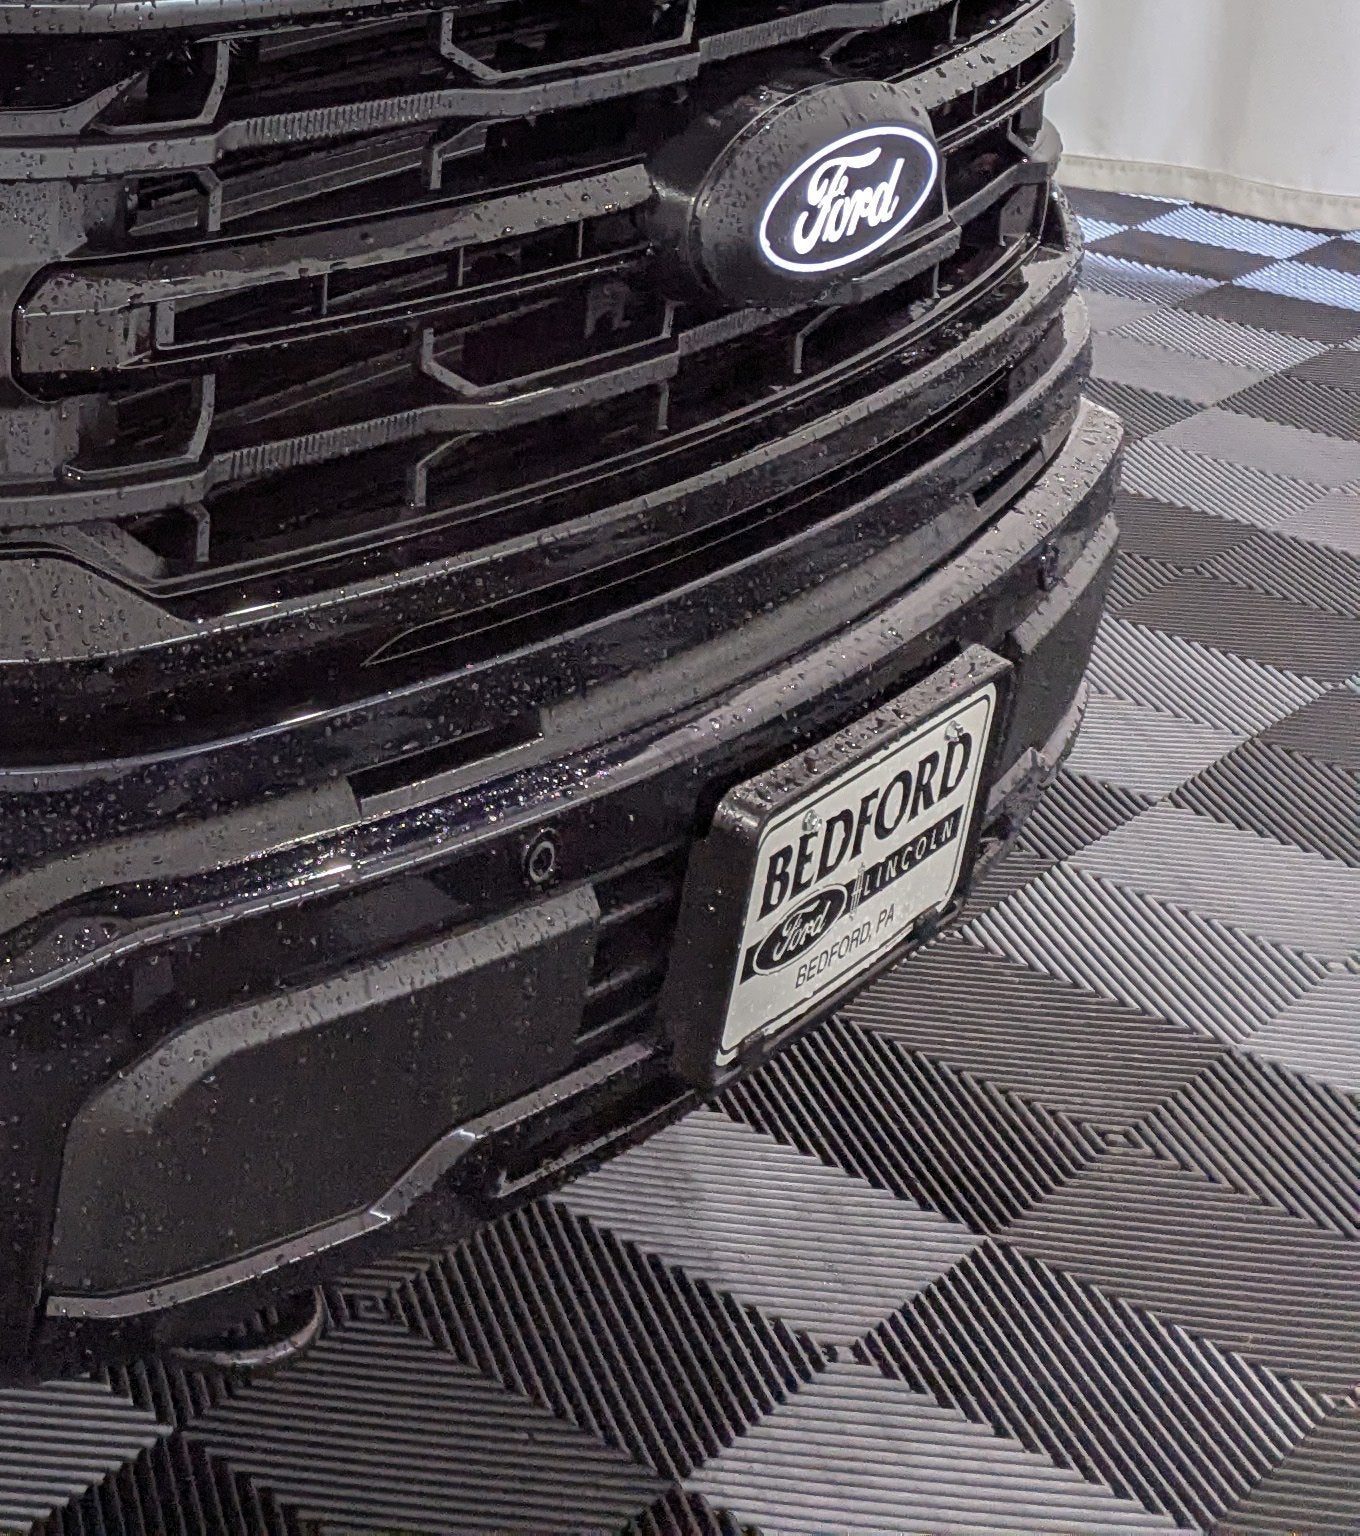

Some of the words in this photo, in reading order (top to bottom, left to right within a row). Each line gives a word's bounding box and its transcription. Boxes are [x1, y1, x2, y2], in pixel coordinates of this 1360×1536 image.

[793, 147, 905, 254] Ford
[756, 732, 973, 922] BEDFORD
[863, 816, 955, 897] LINCOLN
[773, 900, 831, 962] Ford
[795, 920, 872, 989] BEDFORD,
[876, 903, 895, 934] PA
